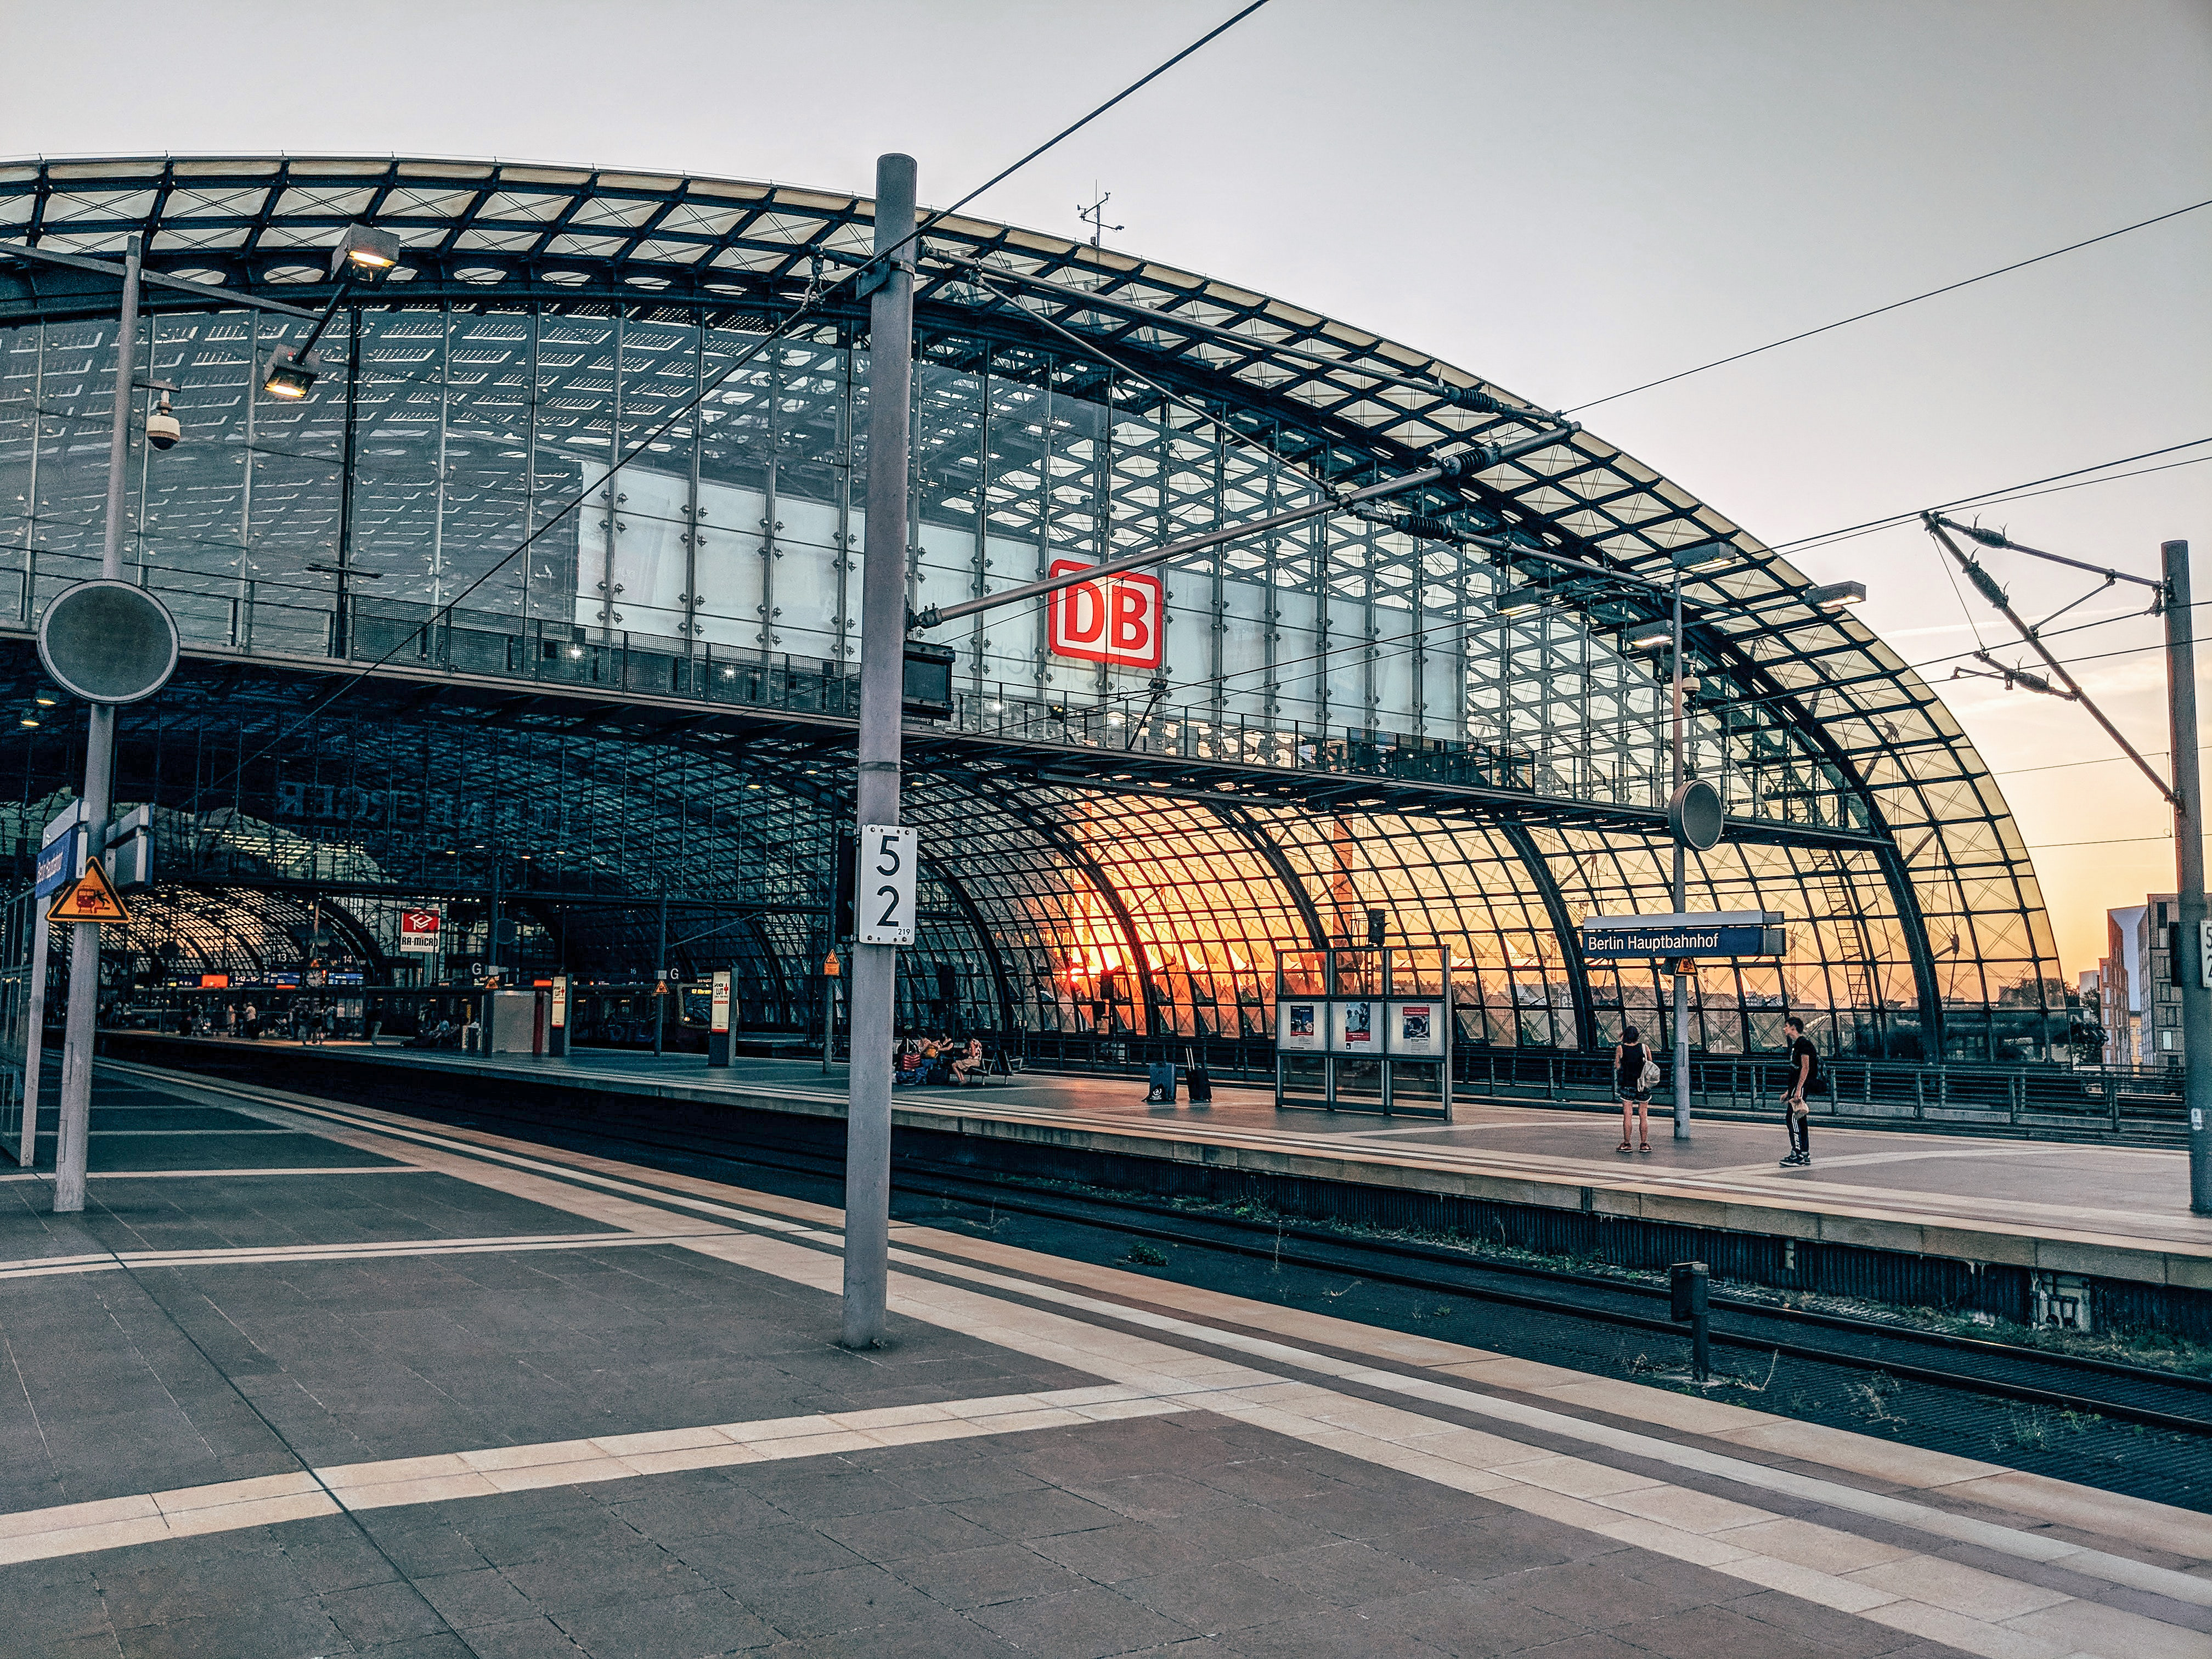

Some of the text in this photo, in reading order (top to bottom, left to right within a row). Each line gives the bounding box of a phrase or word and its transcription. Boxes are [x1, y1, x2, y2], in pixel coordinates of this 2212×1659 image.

[1064, 580, 1149, 650] DB
[876, 835, 900, 876] 5
[876, 885, 900, 927] 2
[1588, 933, 1718, 952] Berlin Hauptbahnhof
[277, 953, 286, 962] 13
[343, 955, 352, 963] 14
[472, 963, 481, 975] G
[670, 968, 679, 979] G
